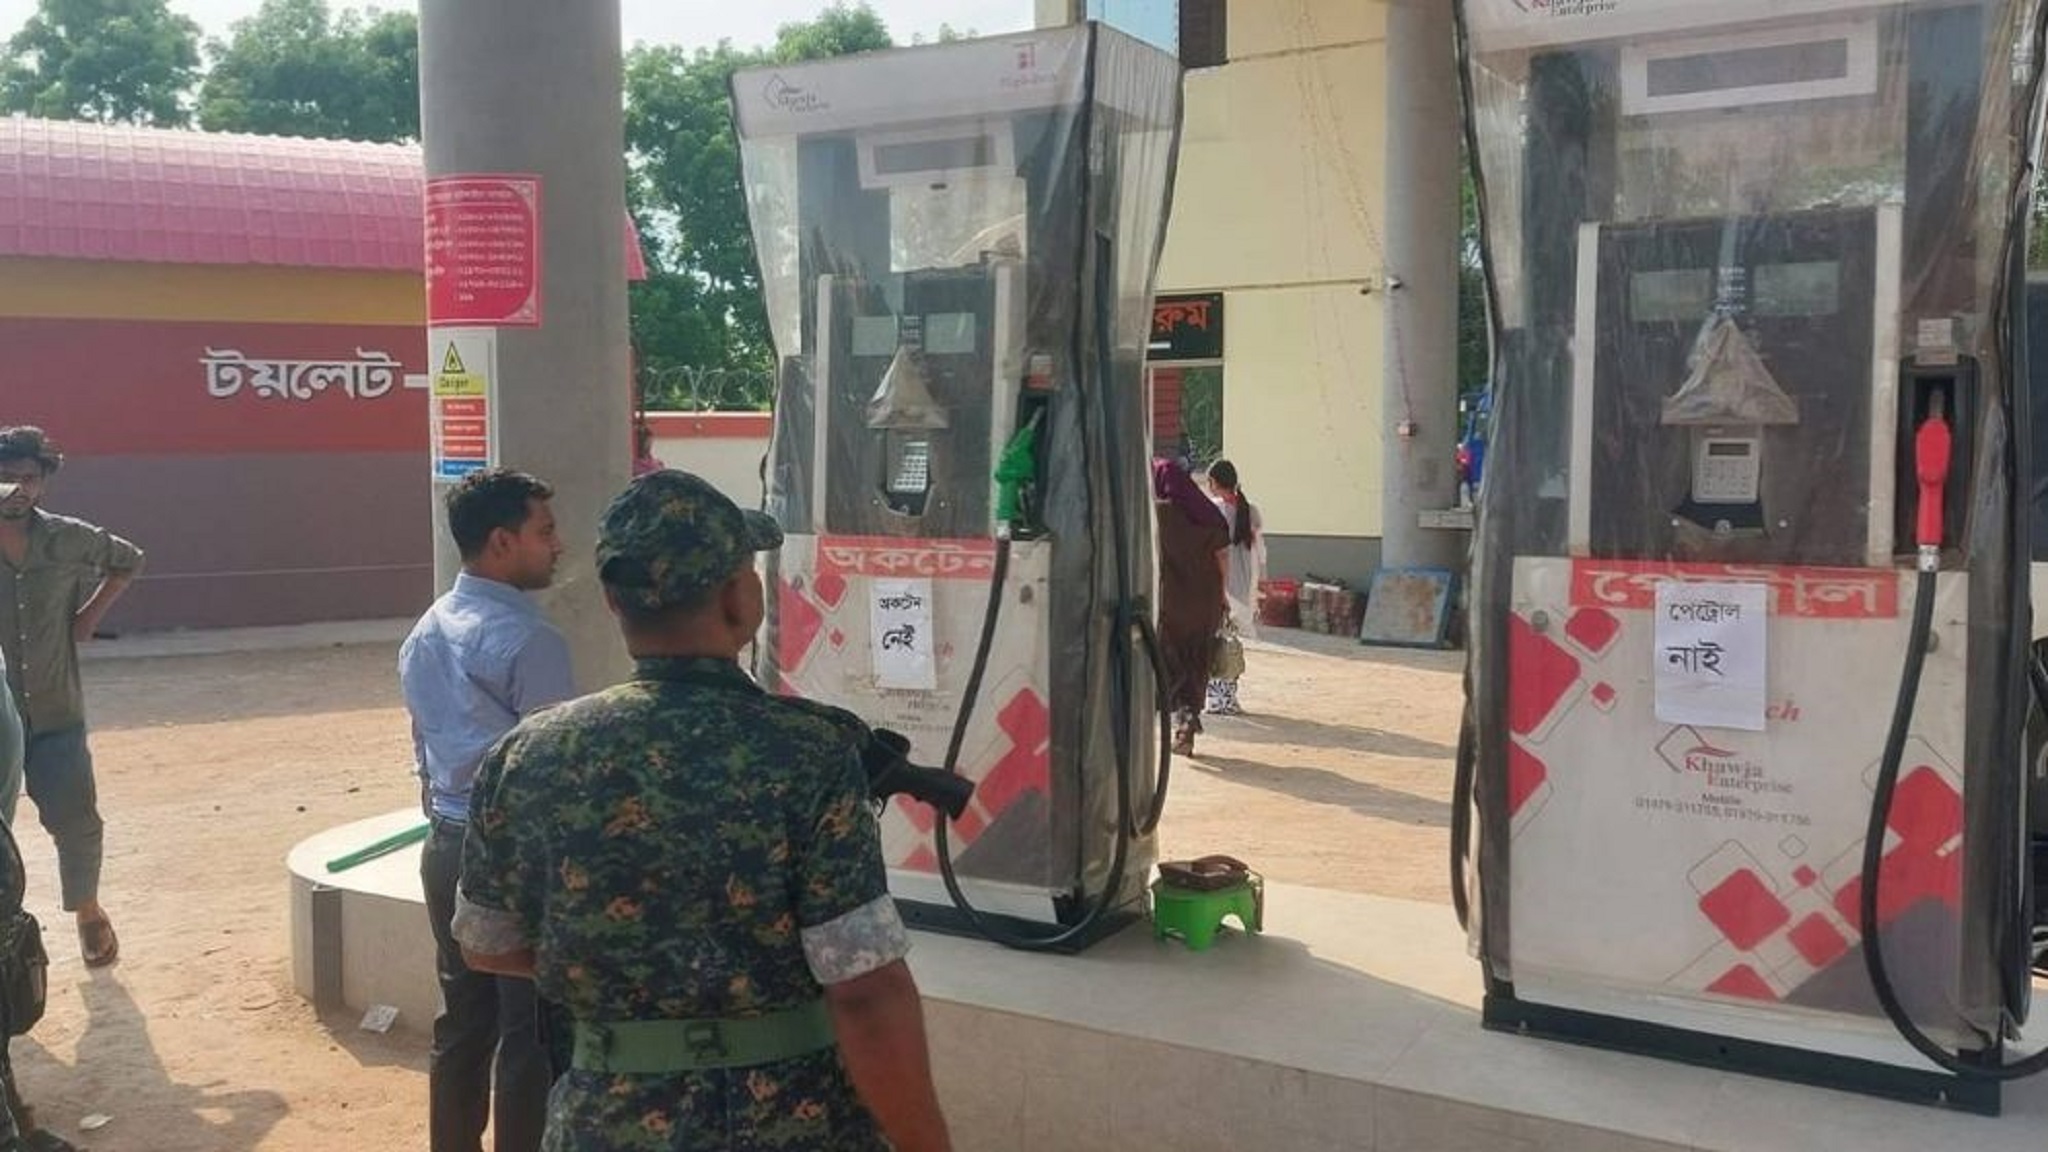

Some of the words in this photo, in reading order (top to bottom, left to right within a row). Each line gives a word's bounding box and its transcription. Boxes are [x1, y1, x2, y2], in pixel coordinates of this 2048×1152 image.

[199, 346, 402, 399] টয়লেট
[1668, 600, 1741, 623] পেট্রোল
[882, 623, 915, 650] নেই
[1666, 637, 1726, 676] নাই
[1685, 756, 1763, 778] Khawja
[1707, 772, 1793, 793] Enterprise
